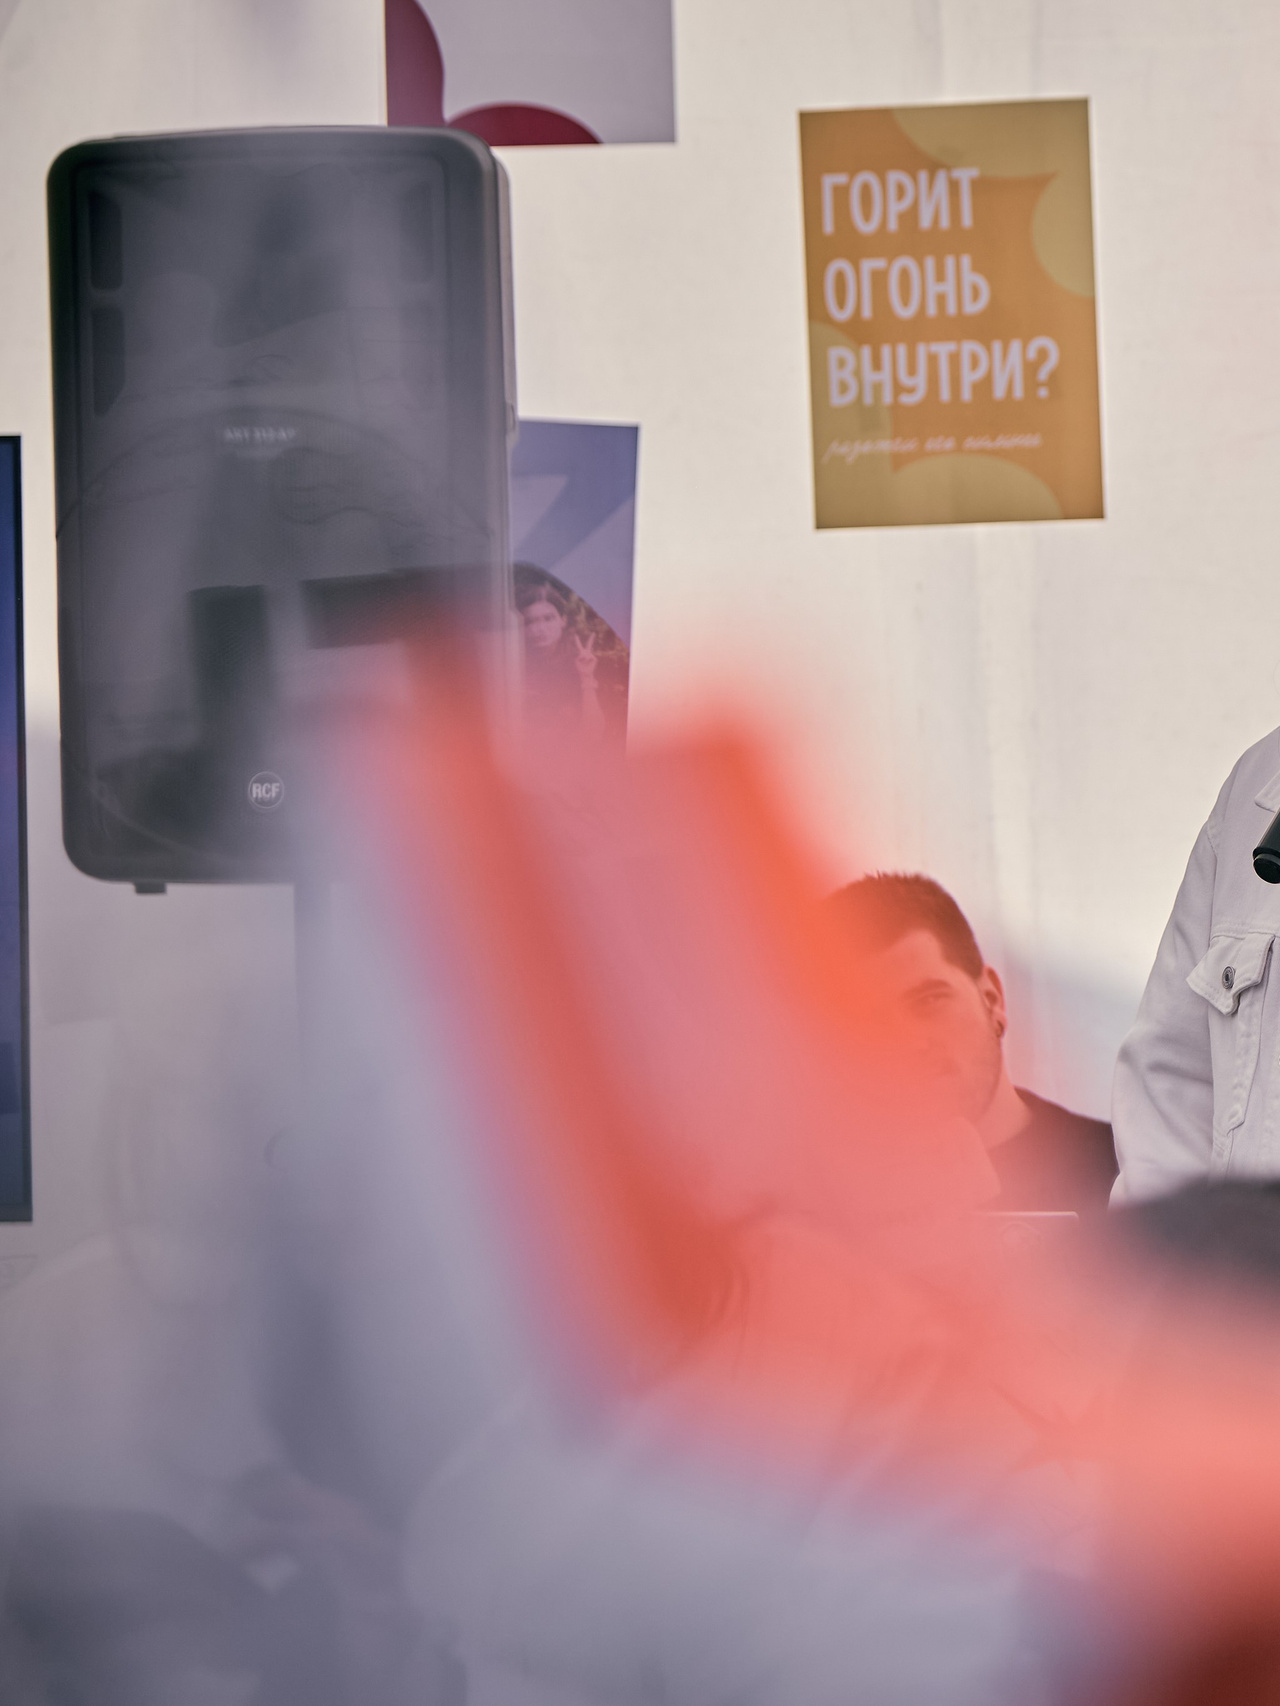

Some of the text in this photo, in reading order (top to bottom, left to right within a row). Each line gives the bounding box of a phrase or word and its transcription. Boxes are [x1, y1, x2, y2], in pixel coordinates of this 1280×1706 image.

[820, 167, 980, 236] ГОРИТ
[823, 253, 991, 323] ОГОНЬ
[827, 336, 1060, 408] ВНУТРИ?
[252, 783, 280, 798] RCF
